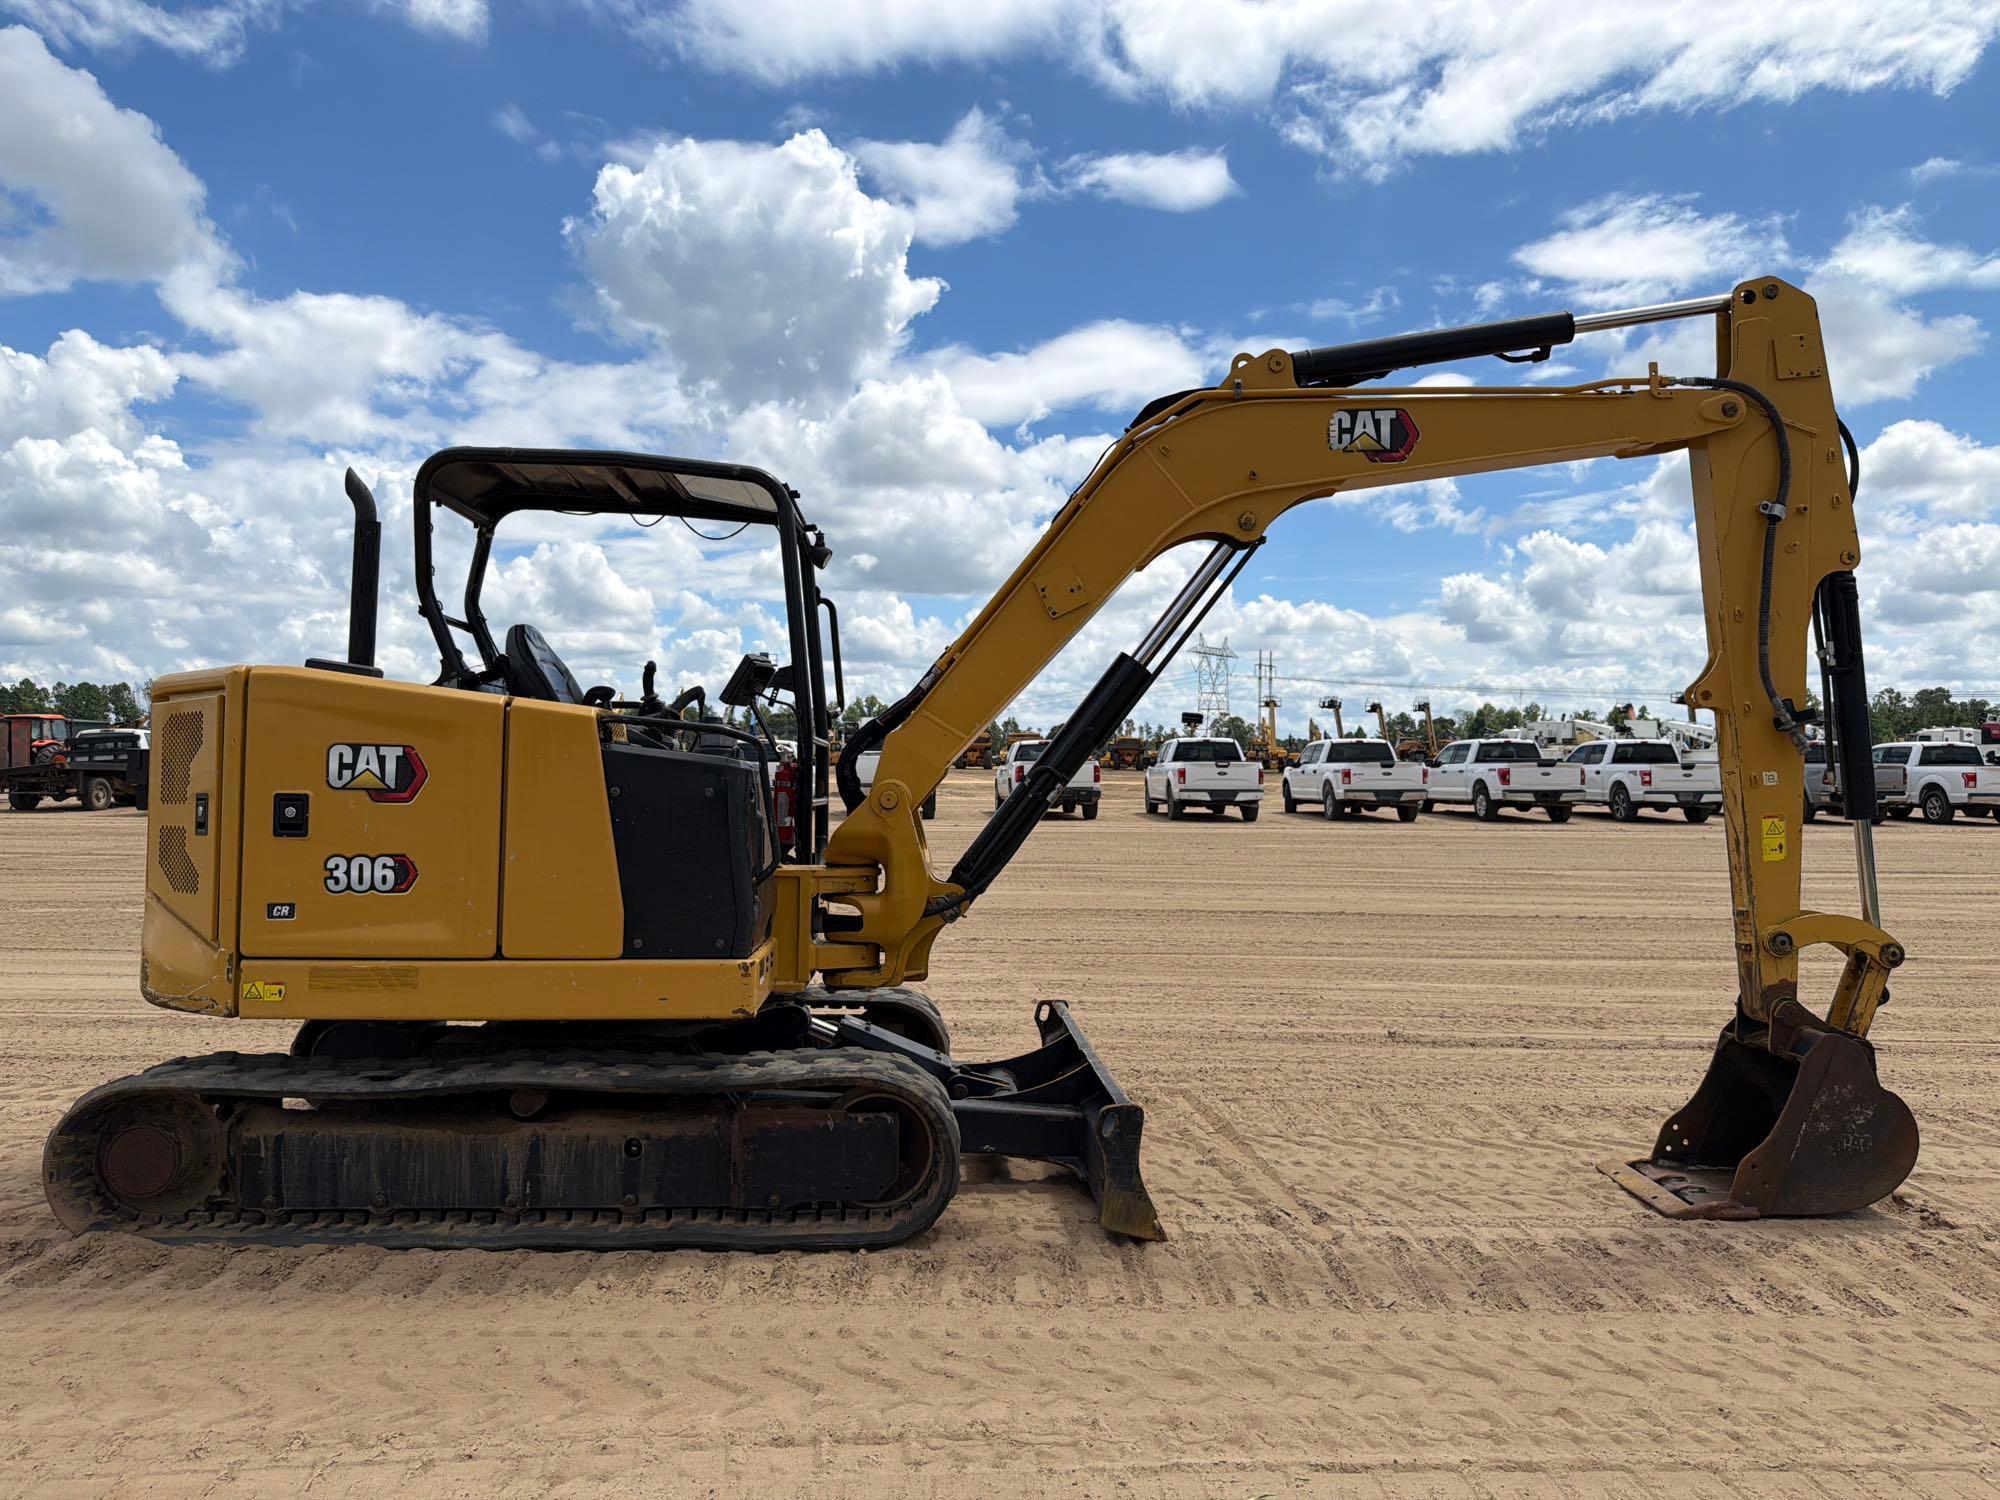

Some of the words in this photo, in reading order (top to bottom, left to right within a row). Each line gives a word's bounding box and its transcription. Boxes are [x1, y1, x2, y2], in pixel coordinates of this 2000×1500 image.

[1329, 409, 1397, 451] CAT
[327, 744, 404, 789] CAT
[326, 856, 395, 892] 306
[272, 905, 290, 917] CR
